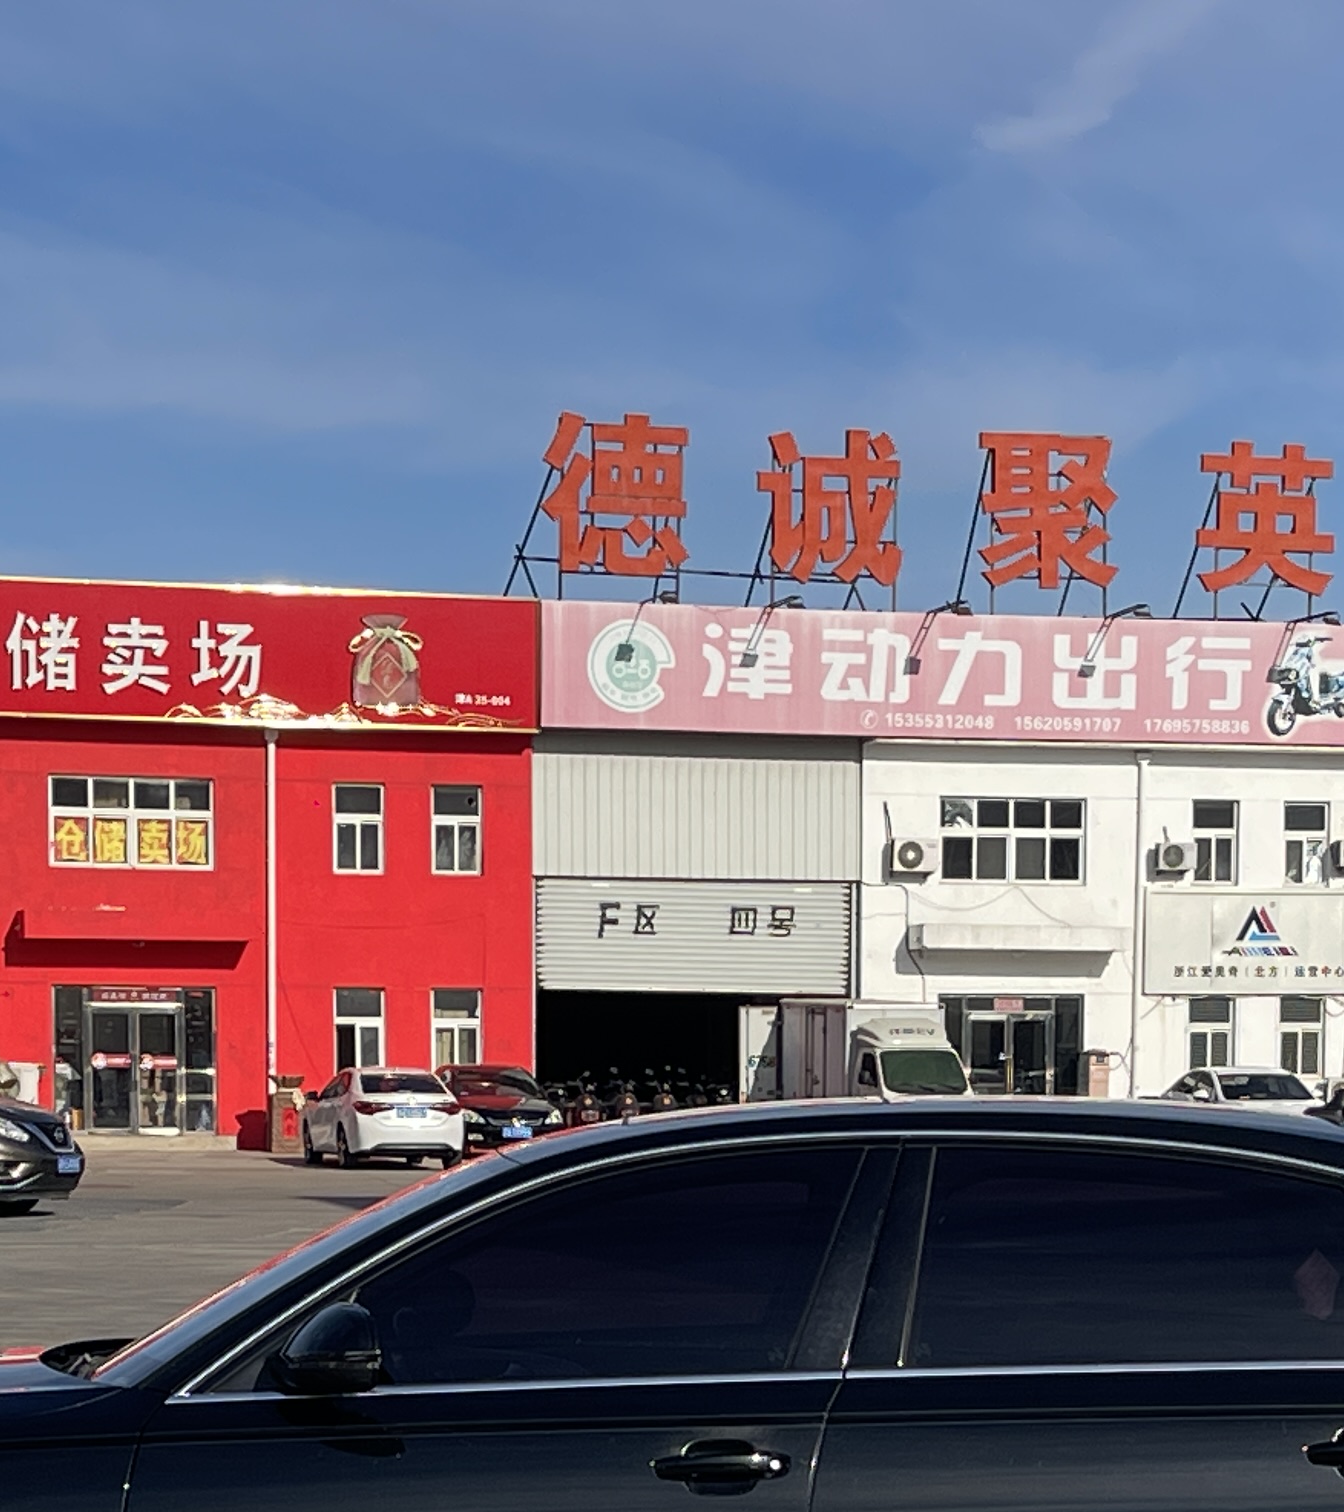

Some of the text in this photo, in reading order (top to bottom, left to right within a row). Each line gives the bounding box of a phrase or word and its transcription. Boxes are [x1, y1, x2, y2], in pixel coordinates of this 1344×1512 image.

[541, 411, 1335, 596] 德诚聚英
[701, 620, 1253, 712] 津动力出行
[55, 818, 208, 865] 仓储卖场
[597, 901, 660, 939] F区
